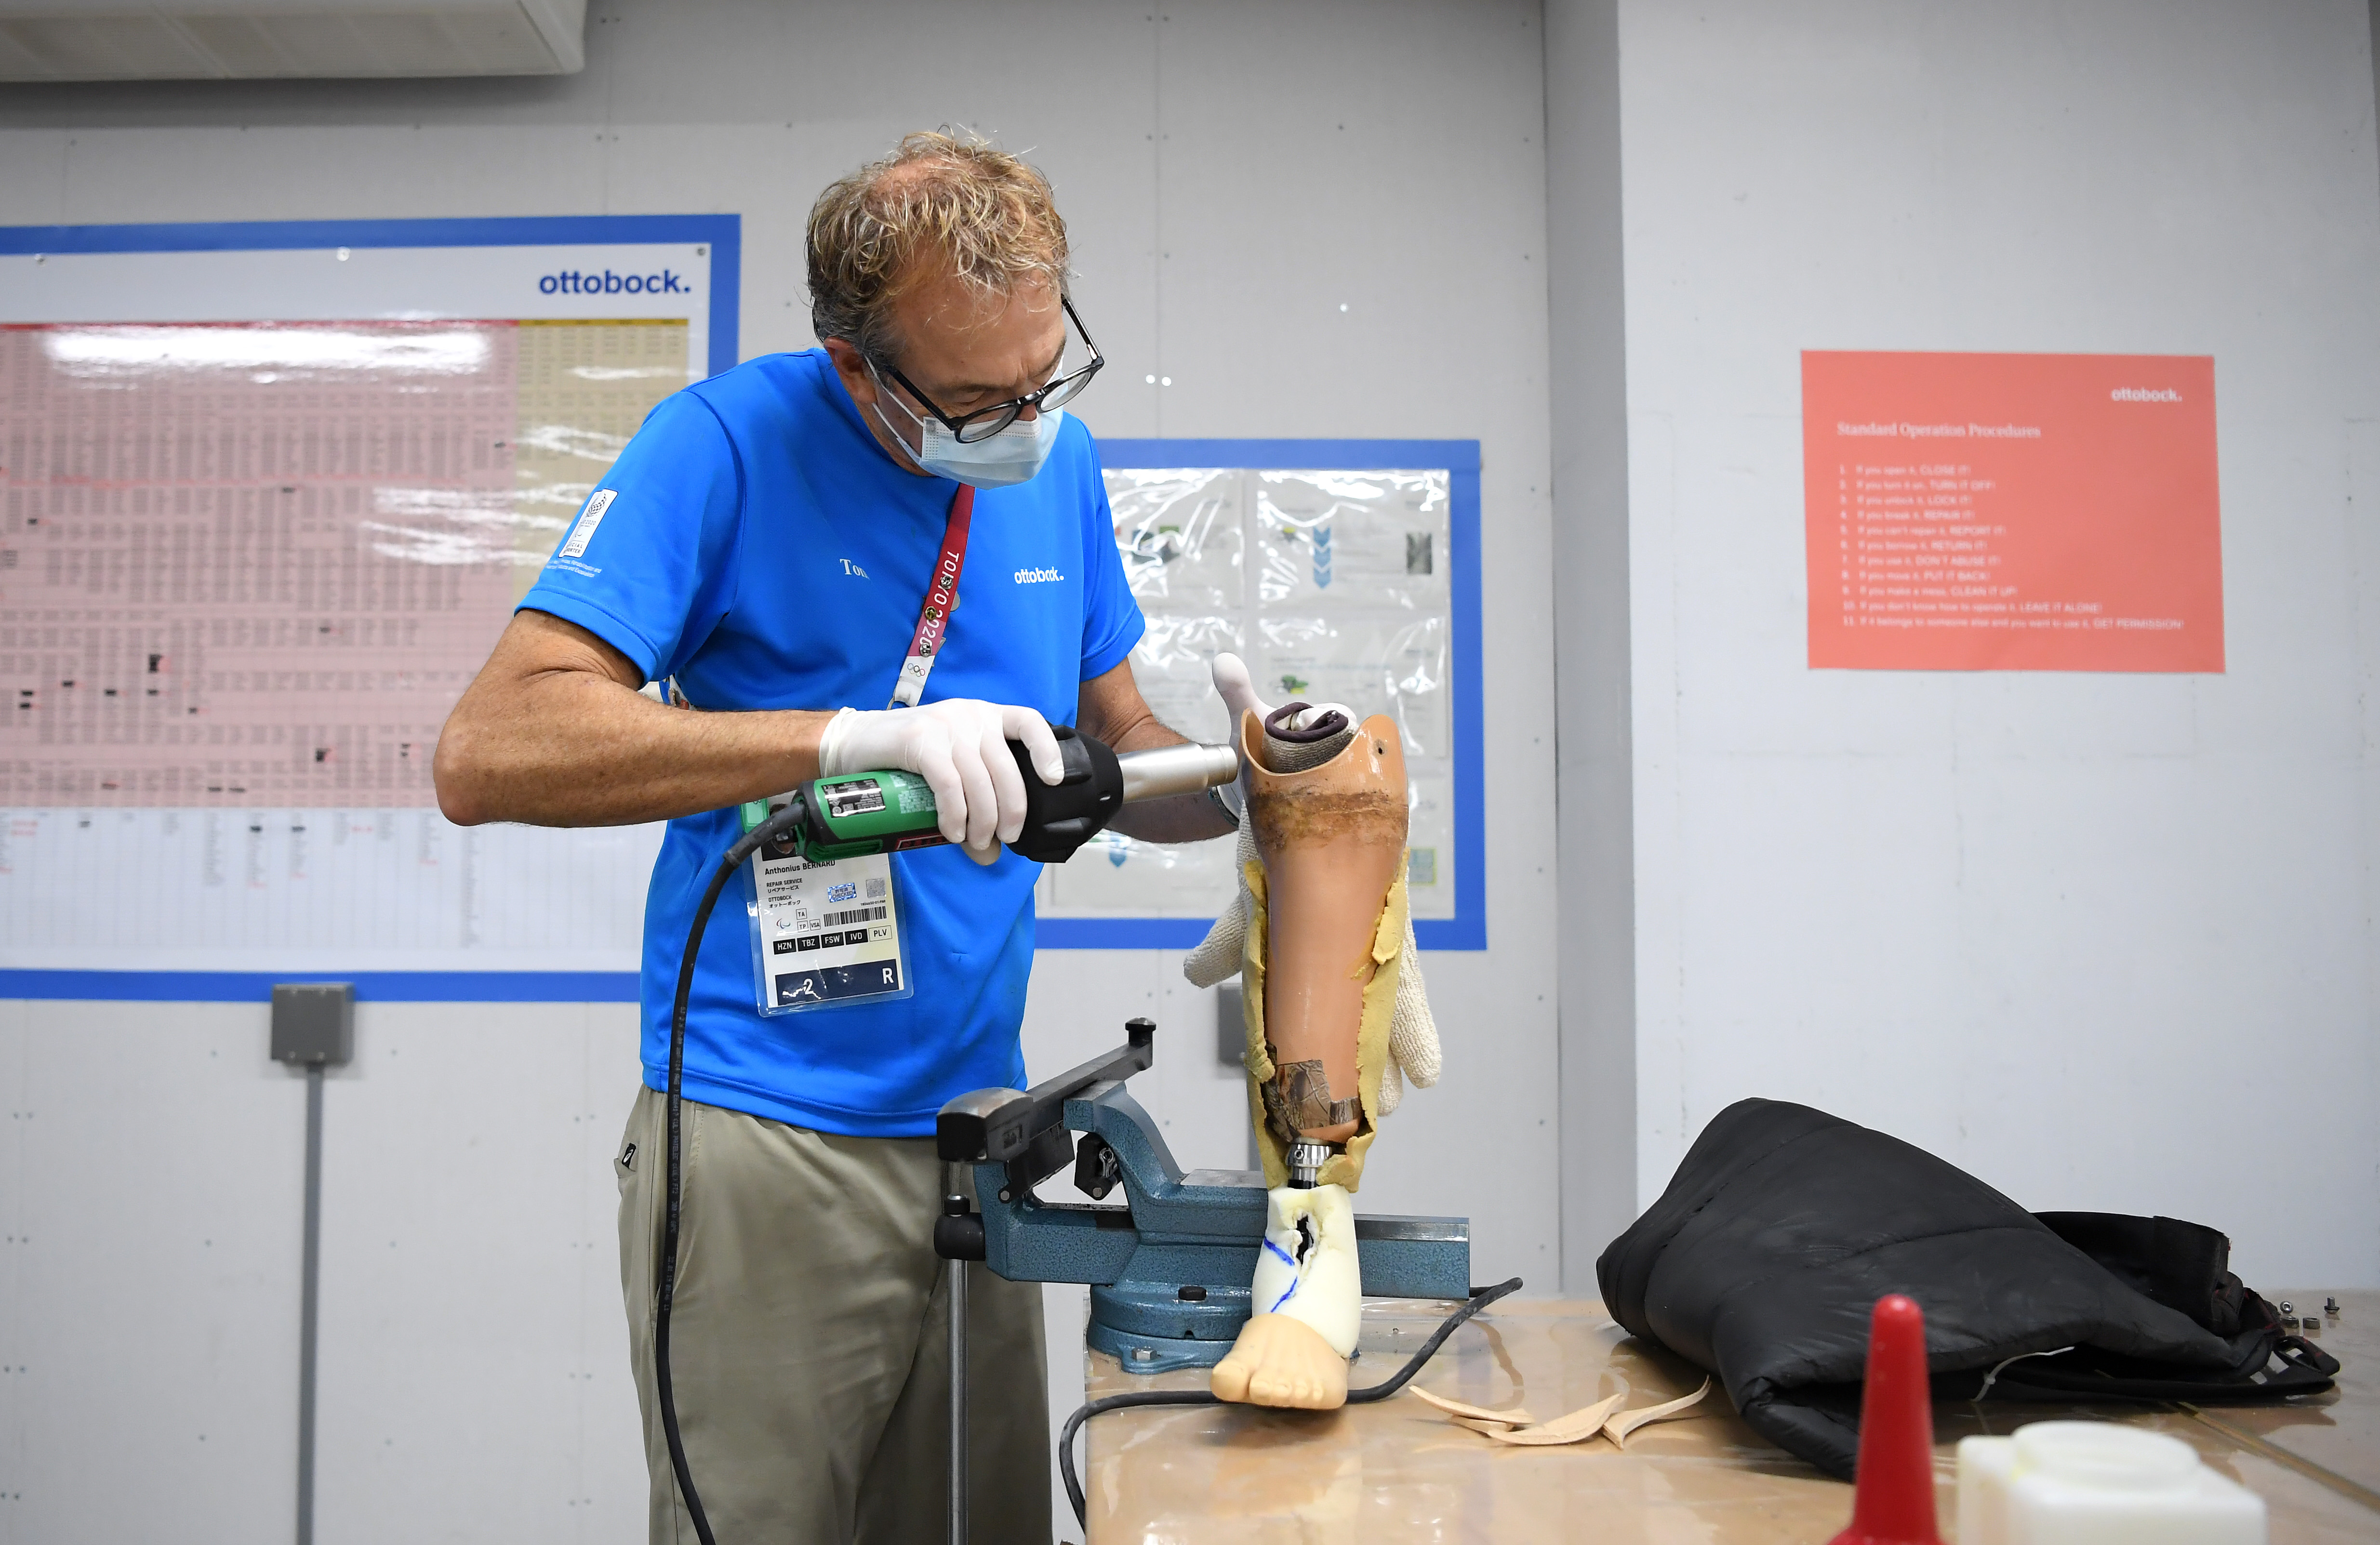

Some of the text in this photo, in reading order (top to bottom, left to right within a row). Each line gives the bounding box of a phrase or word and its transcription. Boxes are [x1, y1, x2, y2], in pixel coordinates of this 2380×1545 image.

[539, 269, 691, 294] ottobock.
[1837, 421, 2041, 439] Standard Operation Procedures
[765, 865, 800, 875] Anthonius
[777, 929, 887, 951] HZN TBZ FSW IVD PLV
[882, 967, 894, 984] R
